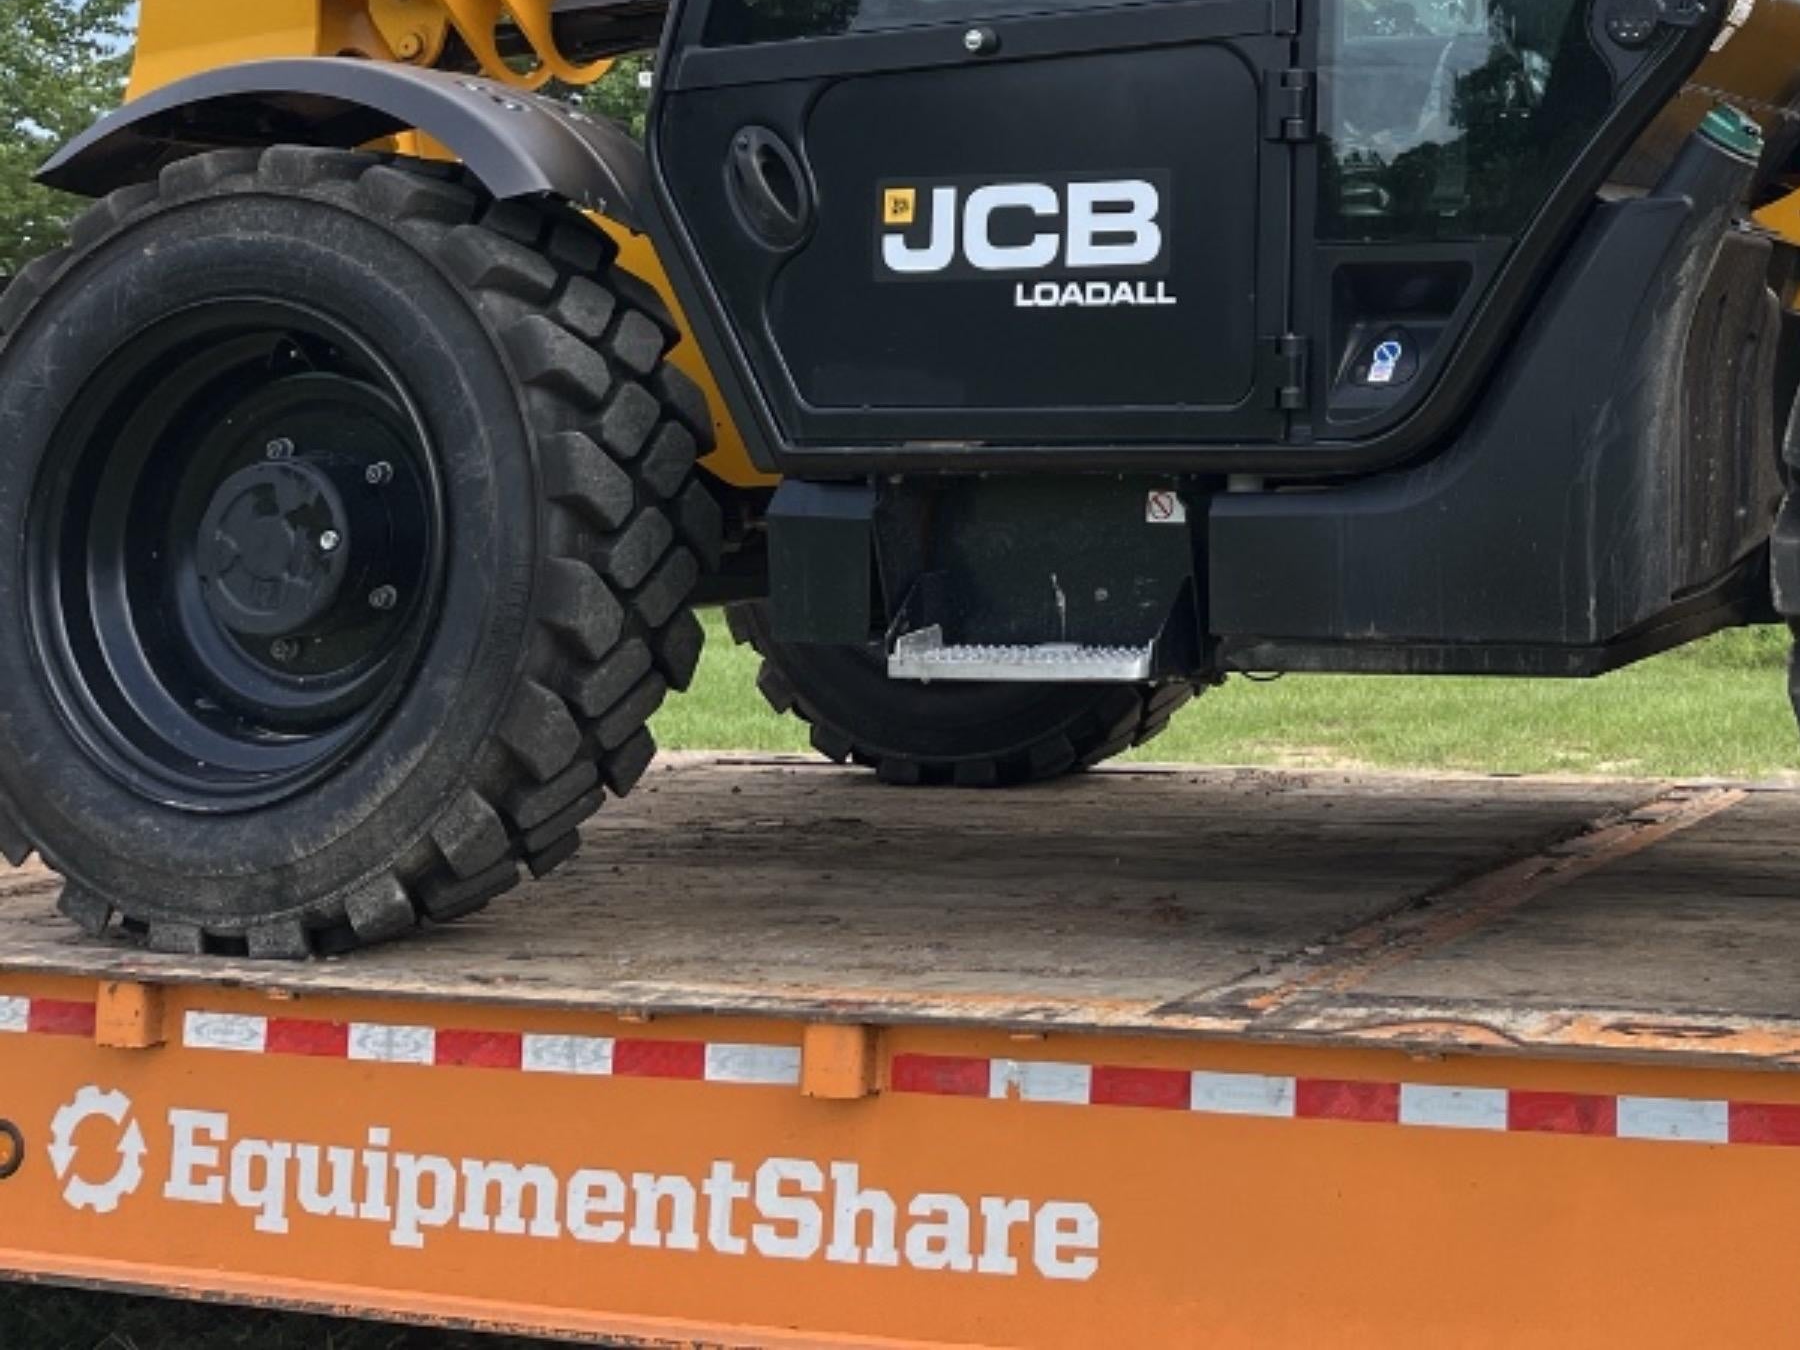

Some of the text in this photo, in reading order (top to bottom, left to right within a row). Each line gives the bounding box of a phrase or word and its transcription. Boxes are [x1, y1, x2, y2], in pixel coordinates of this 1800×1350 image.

[882, 179, 1162, 274] JCB
[1014, 281, 1178, 307] LOADALL
[163, 1107, 1100, 1282] EquipmentShare
